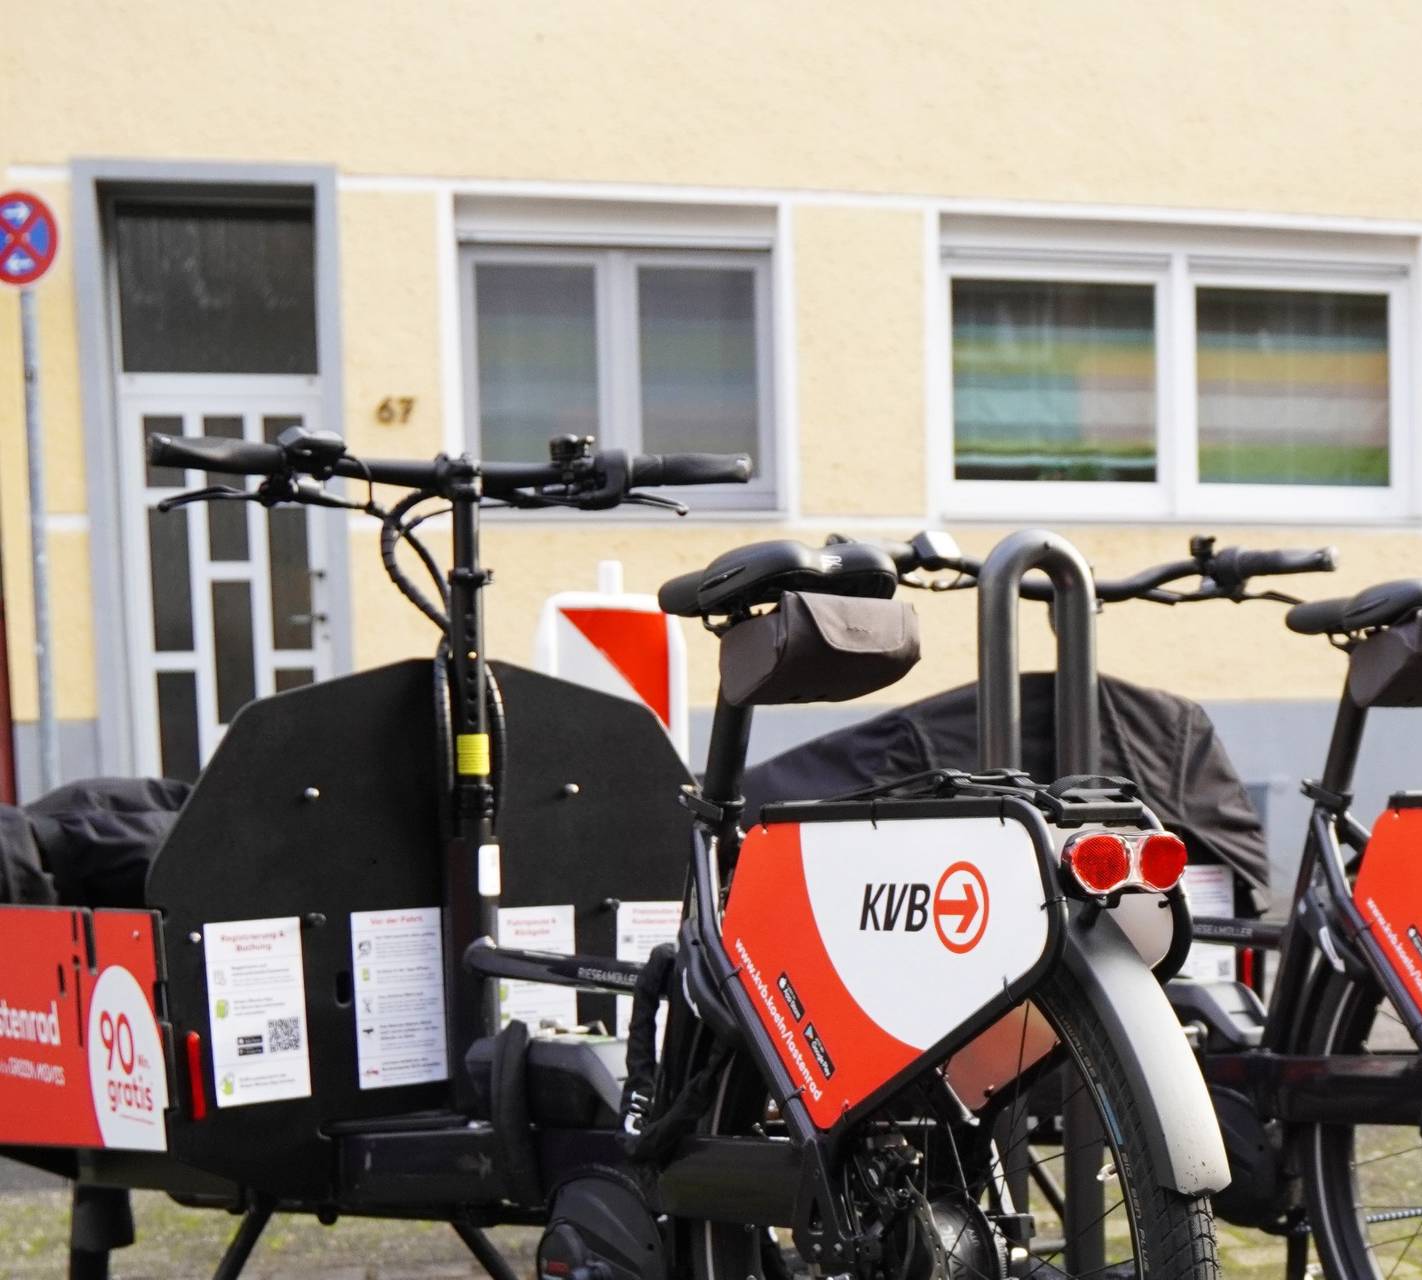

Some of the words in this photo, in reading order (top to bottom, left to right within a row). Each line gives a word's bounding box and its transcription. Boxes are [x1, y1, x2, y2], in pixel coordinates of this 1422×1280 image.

[375, 396, 415, 427] 67
[860, 883, 930, 932] KVB
[100, 1010, 135, 1075] 90
[735, 937, 824, 1102] www.kvb.koeln/lastenrad
[107, 1075, 153, 1112] gratis
